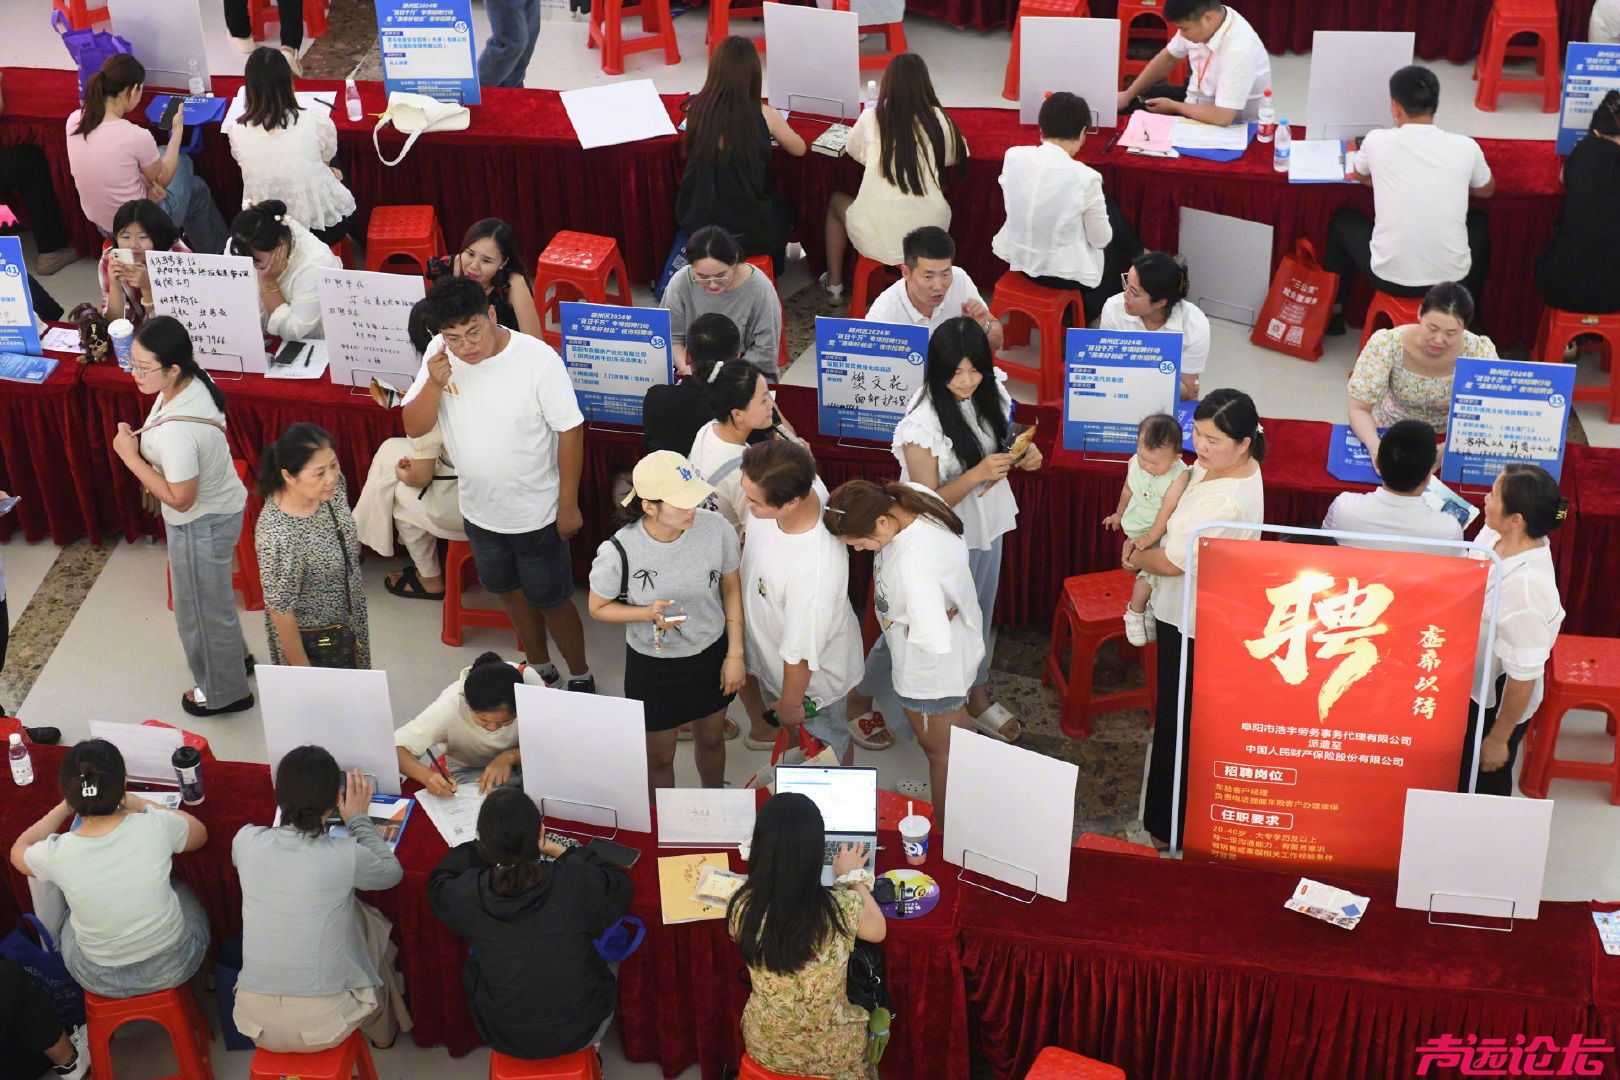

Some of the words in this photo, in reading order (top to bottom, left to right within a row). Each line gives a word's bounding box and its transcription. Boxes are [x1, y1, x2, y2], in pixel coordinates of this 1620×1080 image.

[652, 338, 664, 346] 38
[910, 354, 921, 362] 37
[1161, 363, 1172, 371] 36
[854, 393, 912, 407] 面部护理
[1244, 570, 1395, 723] 聘
[1241, 722, 1412, 746] 阜阳市浩宇劳务事务代理有限公司
[1308, 739, 1343, 750] 派遣至
[1245, 745, 1404, 767] 中国人民财产保险股份有限公司
[1224, 765, 1284, 782] 招聘岗位
[1221, 809, 1280, 826] 任职要求
